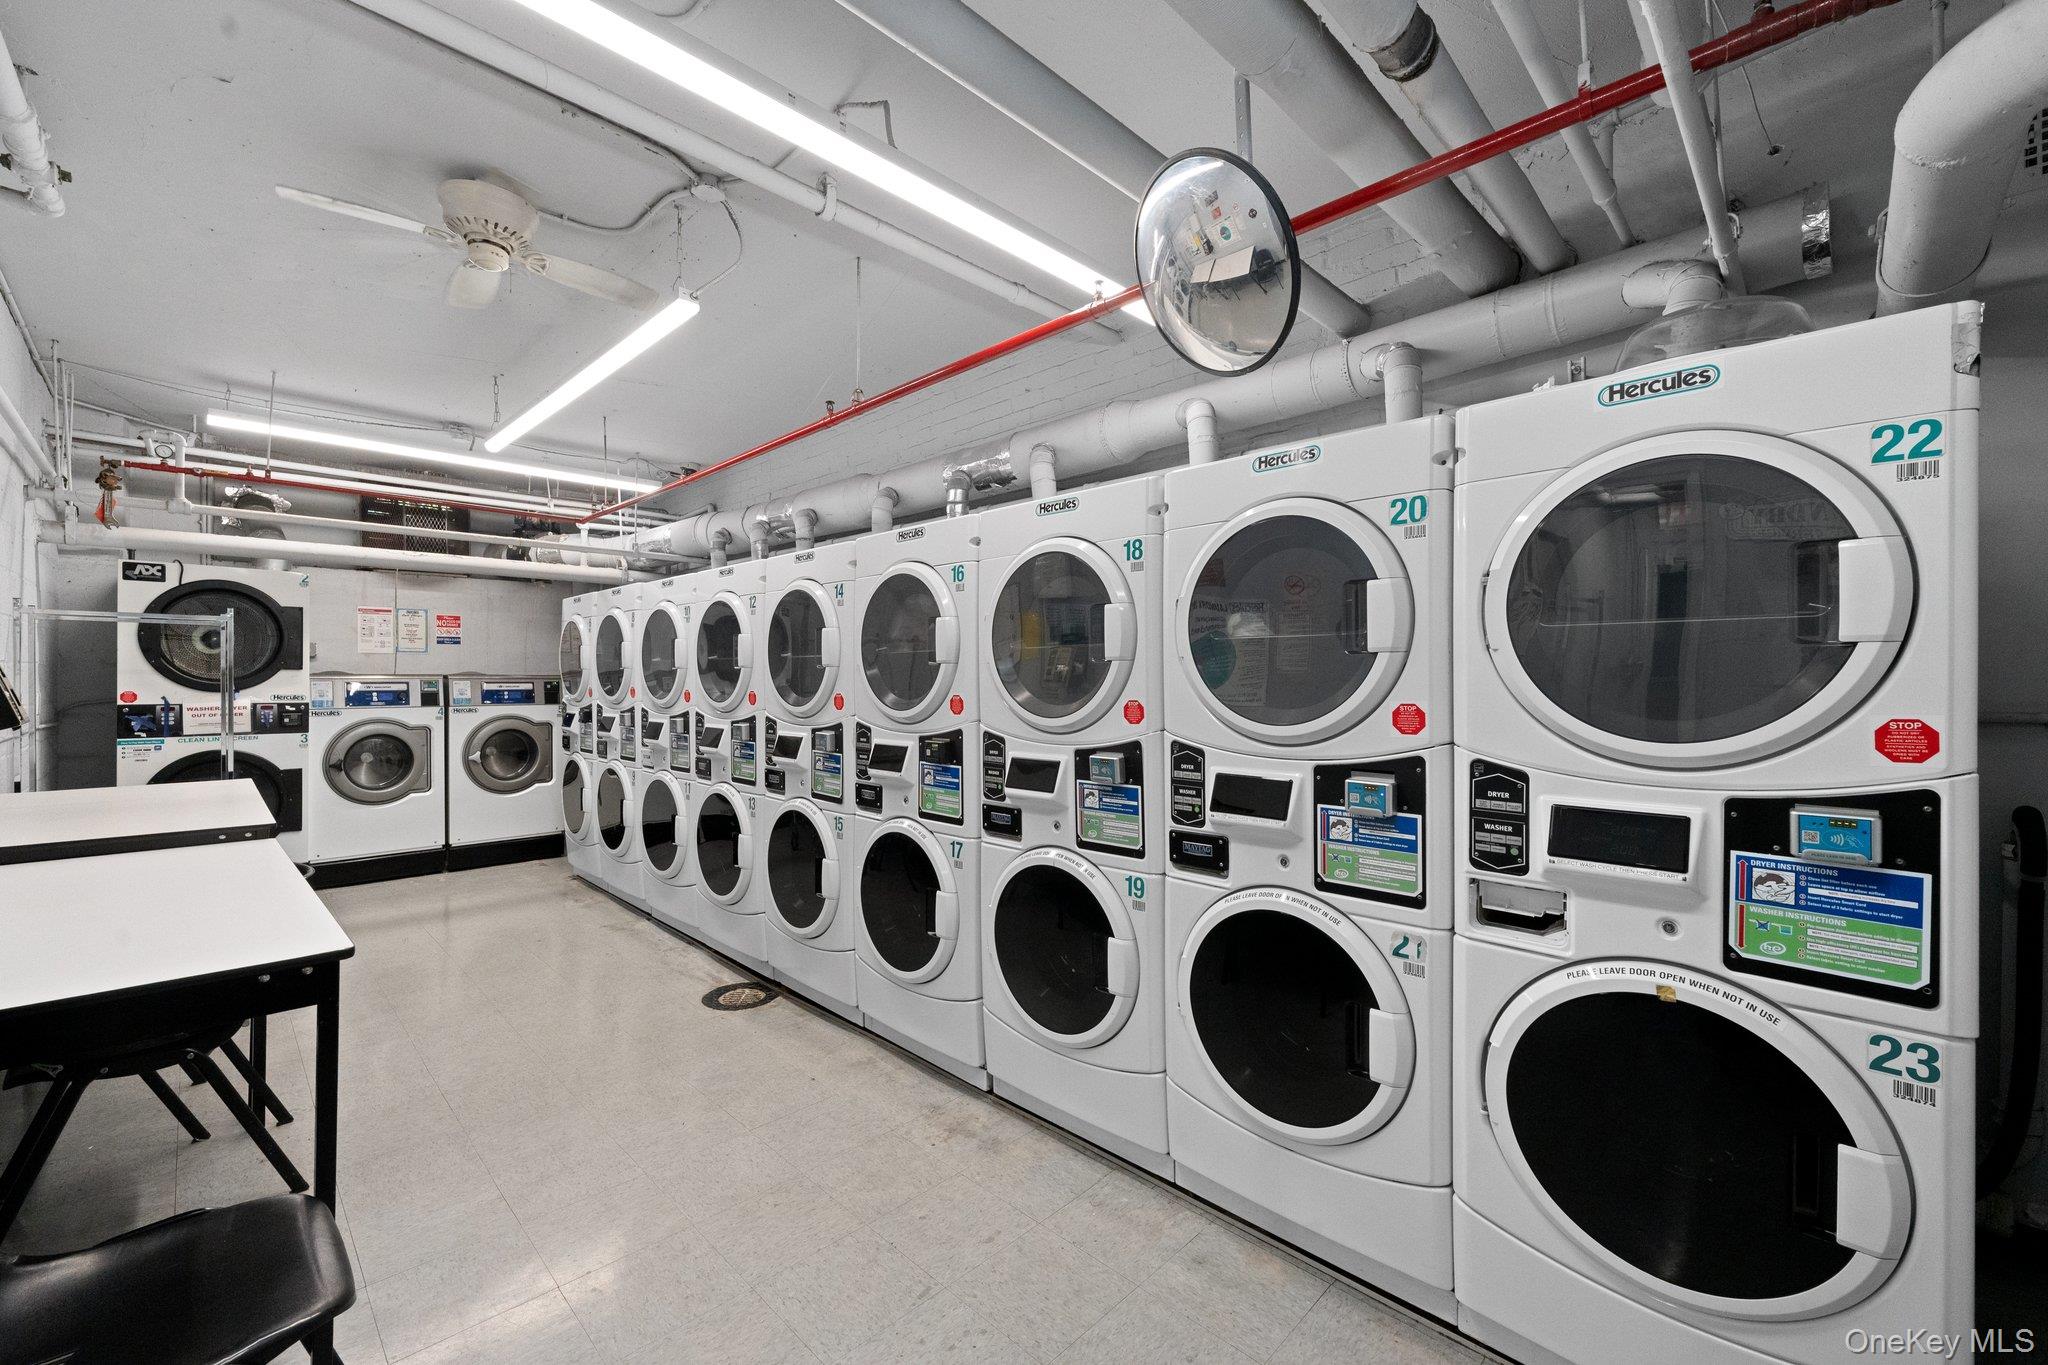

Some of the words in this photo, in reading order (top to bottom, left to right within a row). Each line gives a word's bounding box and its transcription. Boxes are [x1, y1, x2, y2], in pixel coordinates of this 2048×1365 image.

[1608, 368, 1712, 403] Hercules
[1871, 419, 1943, 463] 22
[1257, 448, 1316, 469] Hercules
[1039, 499, 1077, 514] Hercules
[1391, 495, 1427, 524] 20
[898, 529, 924, 540] Hercules
[1123, 538, 1143, 561] 18
[951, 564, 965, 582] 16
[835, 583, 844, 599] 14
[749, 596, 757, 608] 12
[301, 734, 308, 744] 3
[834, 815, 844, 831] 15
[1484, 823, 1513, 832] WASHER
[950, 840, 963, 859] 17
[1184, 844, 1211, 853] MAYTAG
[1598, 864, 1616, 872] CYCLE
[1619, 866, 1636, 874] THEN
[1751, 860, 1775, 869] DRYER
[1778, 862, 1838, 876] INSTRUCTIONS
[1125, 875, 1145, 898] 19
[1291, 897, 1308, 907] WHEN
[1309, 904, 1322, 914] NOT
[1322, 910, 1328, 918] IN
[1329, 915, 1342, 926] USE
[1750, 906, 1783, 916] WASHER
[1786, 910, 1847, 927] INSTRUCTIONS
[1599, 967, 1626, 975] LEAVE
[1629, 967, 1656, 978] DOOR
[1659, 971, 1686, 985] OPEN
[1688, 979, 1720, 995] WHEN
[1722, 990, 1745, 1005] NOT
[1745, 1002, 1758, 1013] IN
[1759, 1009, 1781, 1026] USE
[1869, 1034, 1941, 1083] 23
